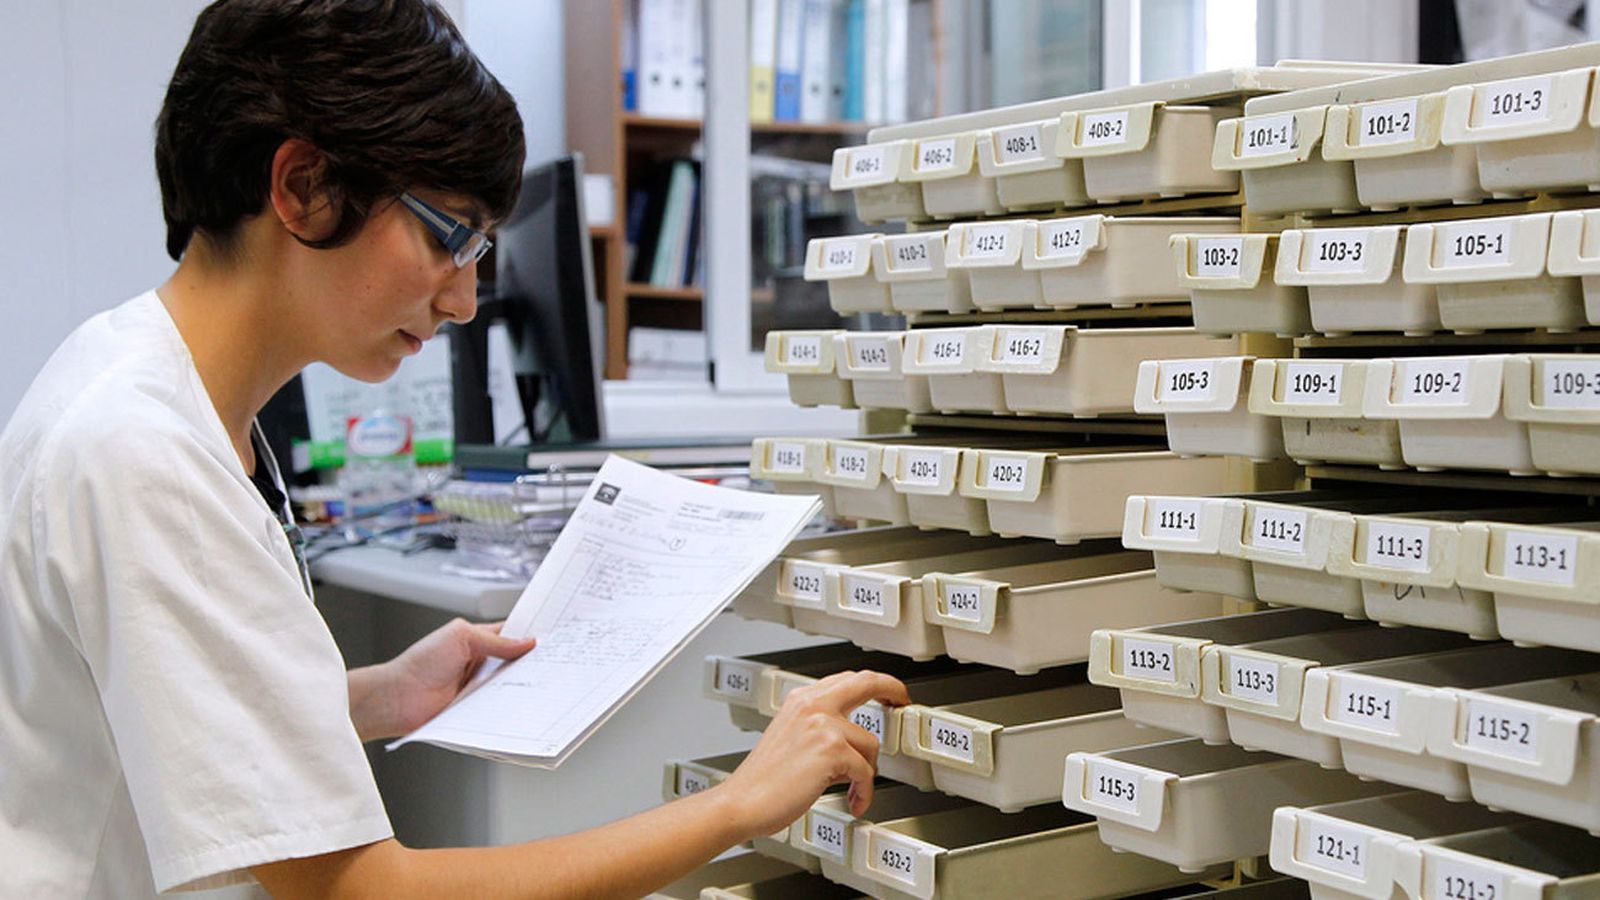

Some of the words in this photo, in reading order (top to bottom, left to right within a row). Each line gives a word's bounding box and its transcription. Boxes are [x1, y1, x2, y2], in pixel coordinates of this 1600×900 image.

[1492, 90, 1542, 114] 101-3
[1087, 118, 1122, 139] 408-2
[1368, 114, 1410, 135] 101-2
[1006, 136, 1037, 154] 408-1
[1248, 128, 1287, 147] 101-1
[855, 157, 879, 173] 406-1
[924, 147, 952, 165] 406-2
[977, 234, 1004, 251] 412-1
[1052, 229, 1081, 248] 412-2
[1455, 235, 1503, 256] 105-1
[899, 244, 925, 261] 410-2
[1204, 248, 1238, 266] 103-2
[1319, 242, 1362, 261] 103-3
[792, 345, 817, 359] 414-1
[860, 348, 886, 363] 414-2
[934, 342, 961, 358] 416-1
[1010, 339, 1040, 356] 416-2
[1171, 372, 1208, 391] 105-3
[1294, 374, 1336, 393] 109-1
[1414, 373, 1461, 393] 109-2
[1553, 373, 1600, 394] 109-3
[776, 452, 801, 467] 418-1
[840, 456, 865, 473] 418-2
[911, 461, 936, 478] 420-1
[993, 466, 1022, 483] 420-2
[1160, 511, 1195, 530] 111-1
[1261, 520, 1301, 541] 111-2
[1377, 535, 1422, 559] 111-3
[1515, 545, 1566, 570] 113-1
[792, 576, 819, 592] 422-2
[854, 588, 880, 605] 424-1
[951, 593, 977, 610] 424-2
[1130, 649, 1170, 671] 113-2
[727, 674, 749, 691] 426-1
[1237, 669, 1274, 693] 113-3
[1348, 693, 1391, 720] 115-1
[855, 713, 880, 734] 428-1
[1477, 716, 1530, 744] 115-2
[937, 729, 969, 750] 428-2
[1099, 776, 1135, 801] 115-3
[816, 824, 841, 846] 432-1
[1317, 835, 1359, 864] 121-1
[881, 849, 911, 873] 432-2
